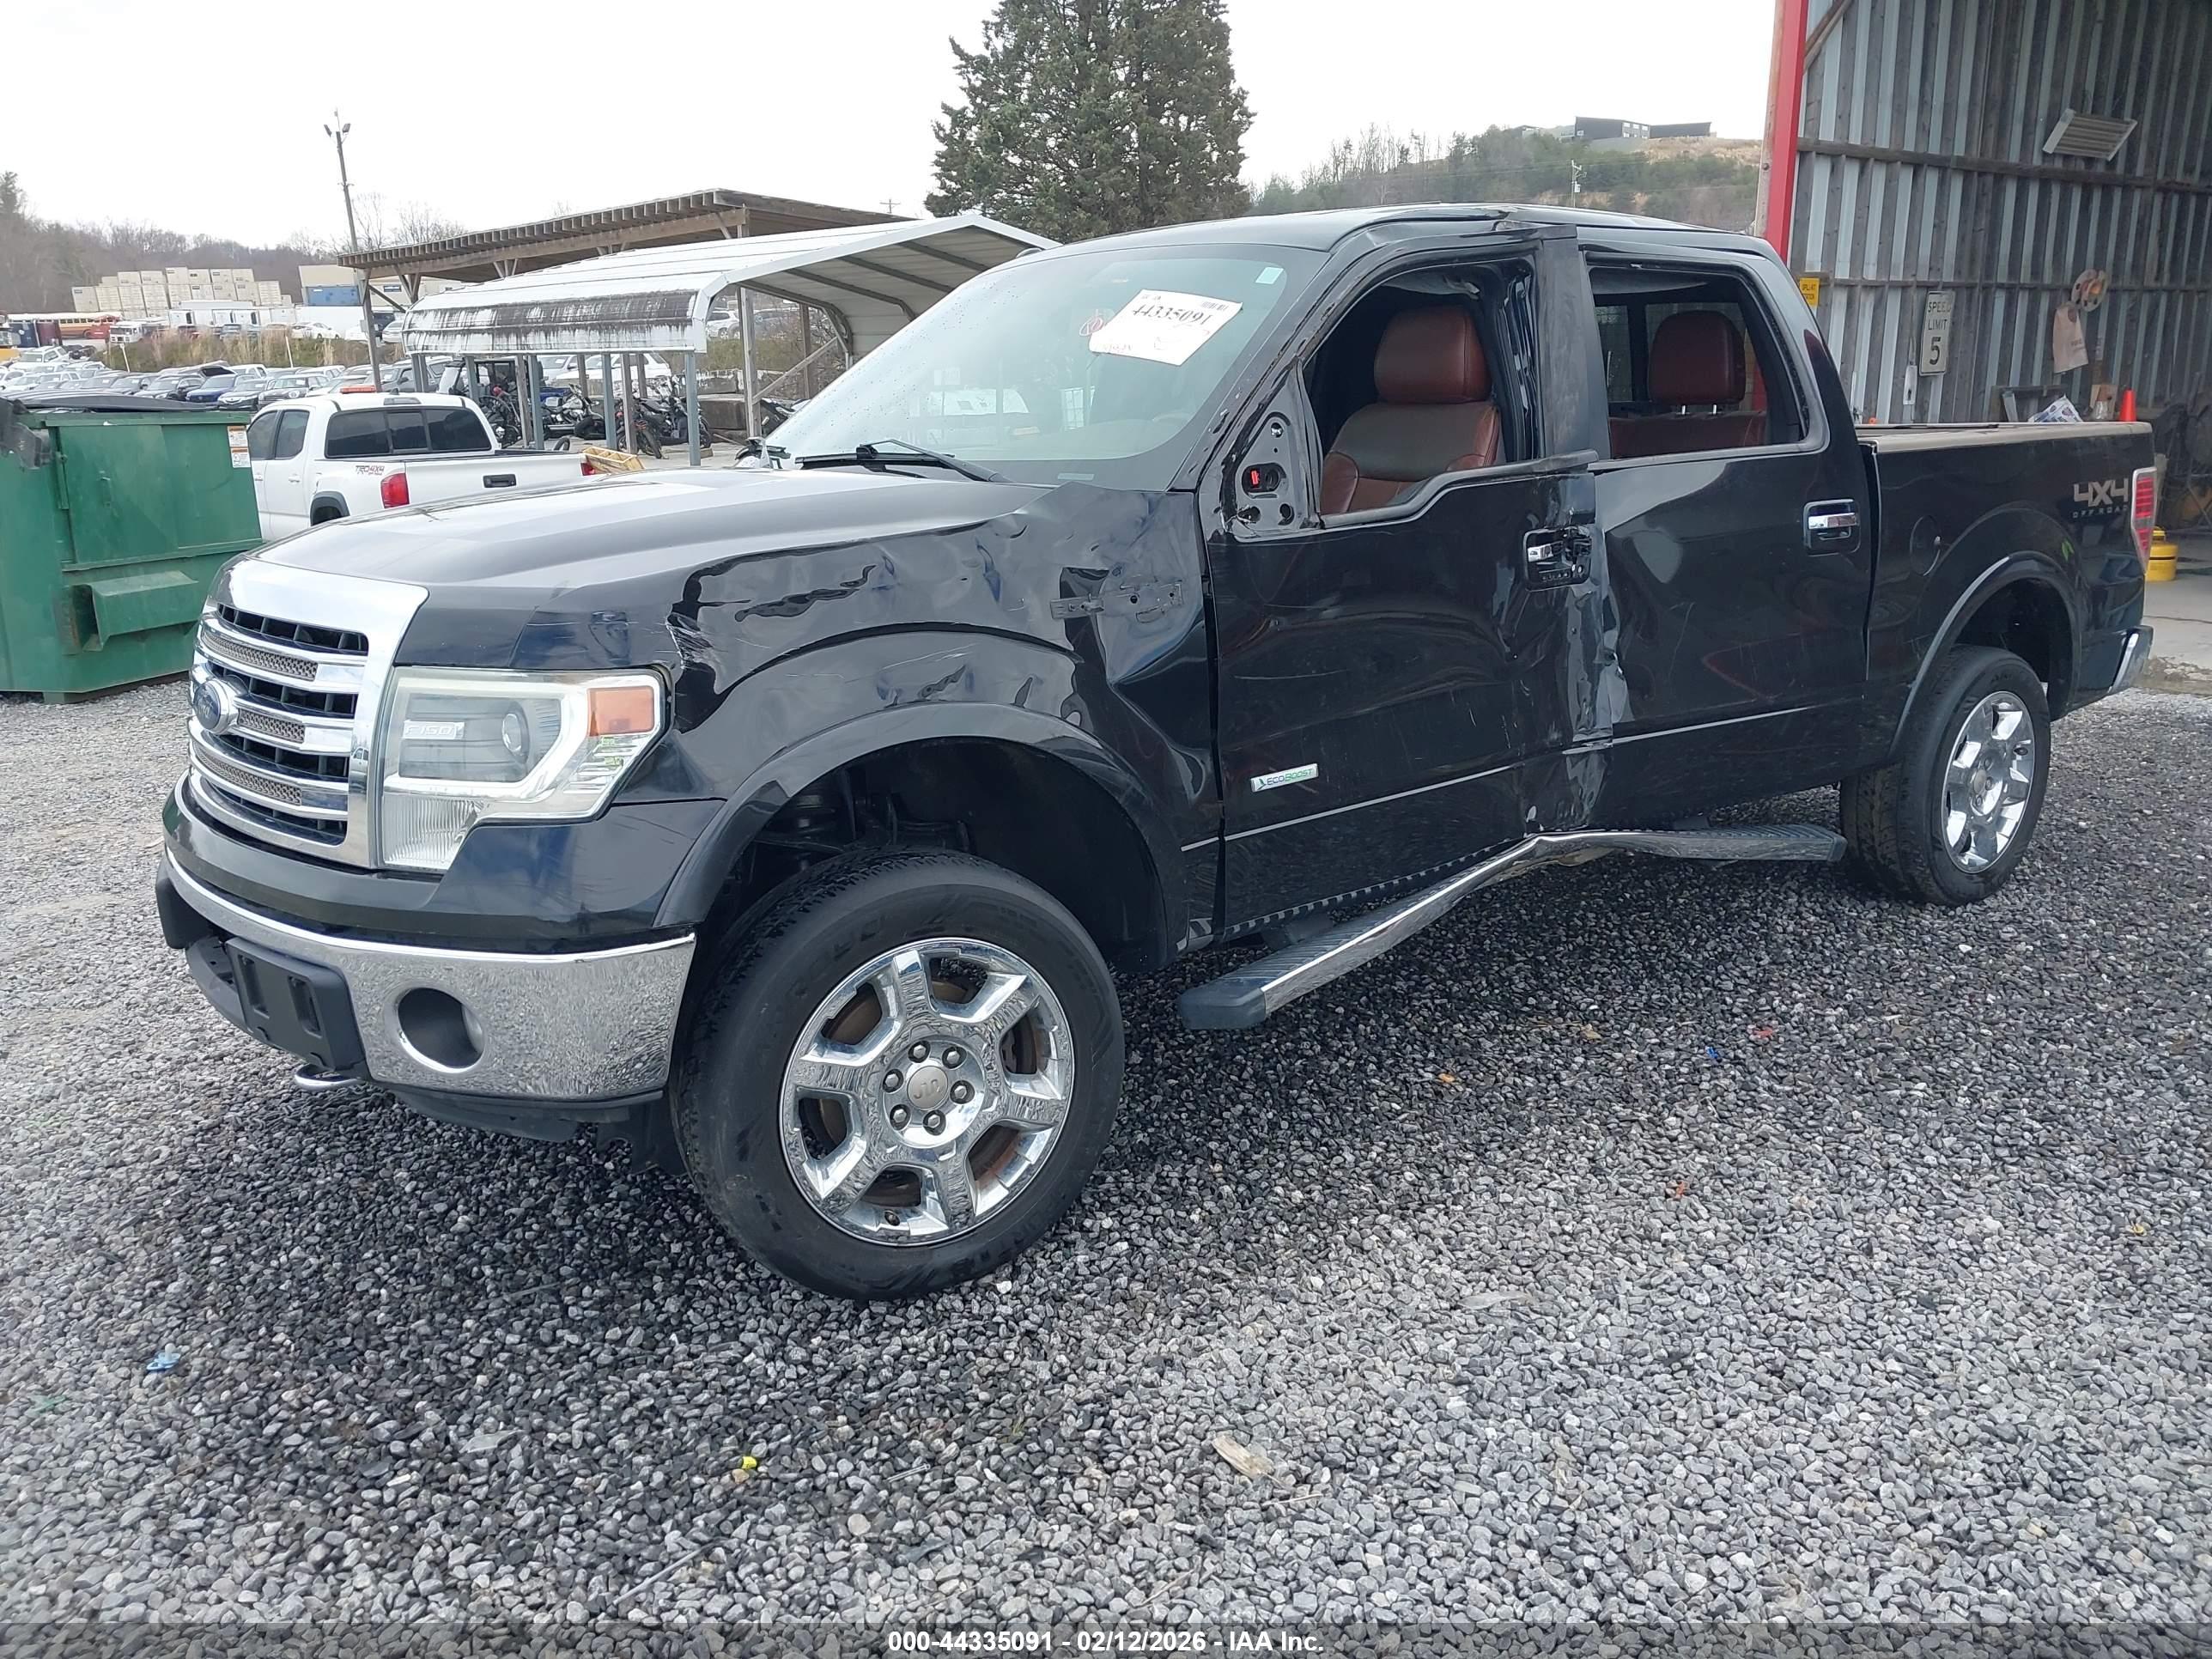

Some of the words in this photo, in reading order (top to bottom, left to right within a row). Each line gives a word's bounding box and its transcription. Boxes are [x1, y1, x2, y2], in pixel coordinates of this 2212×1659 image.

[1132, 304, 1213, 325] 44335091
[1928, 301, 1951, 313] SPEED
[1928, 319, 1948, 331] LIMIT
[1929, 336, 1942, 365] 5
[1267, 769, 1314, 786] ECOBOOST
